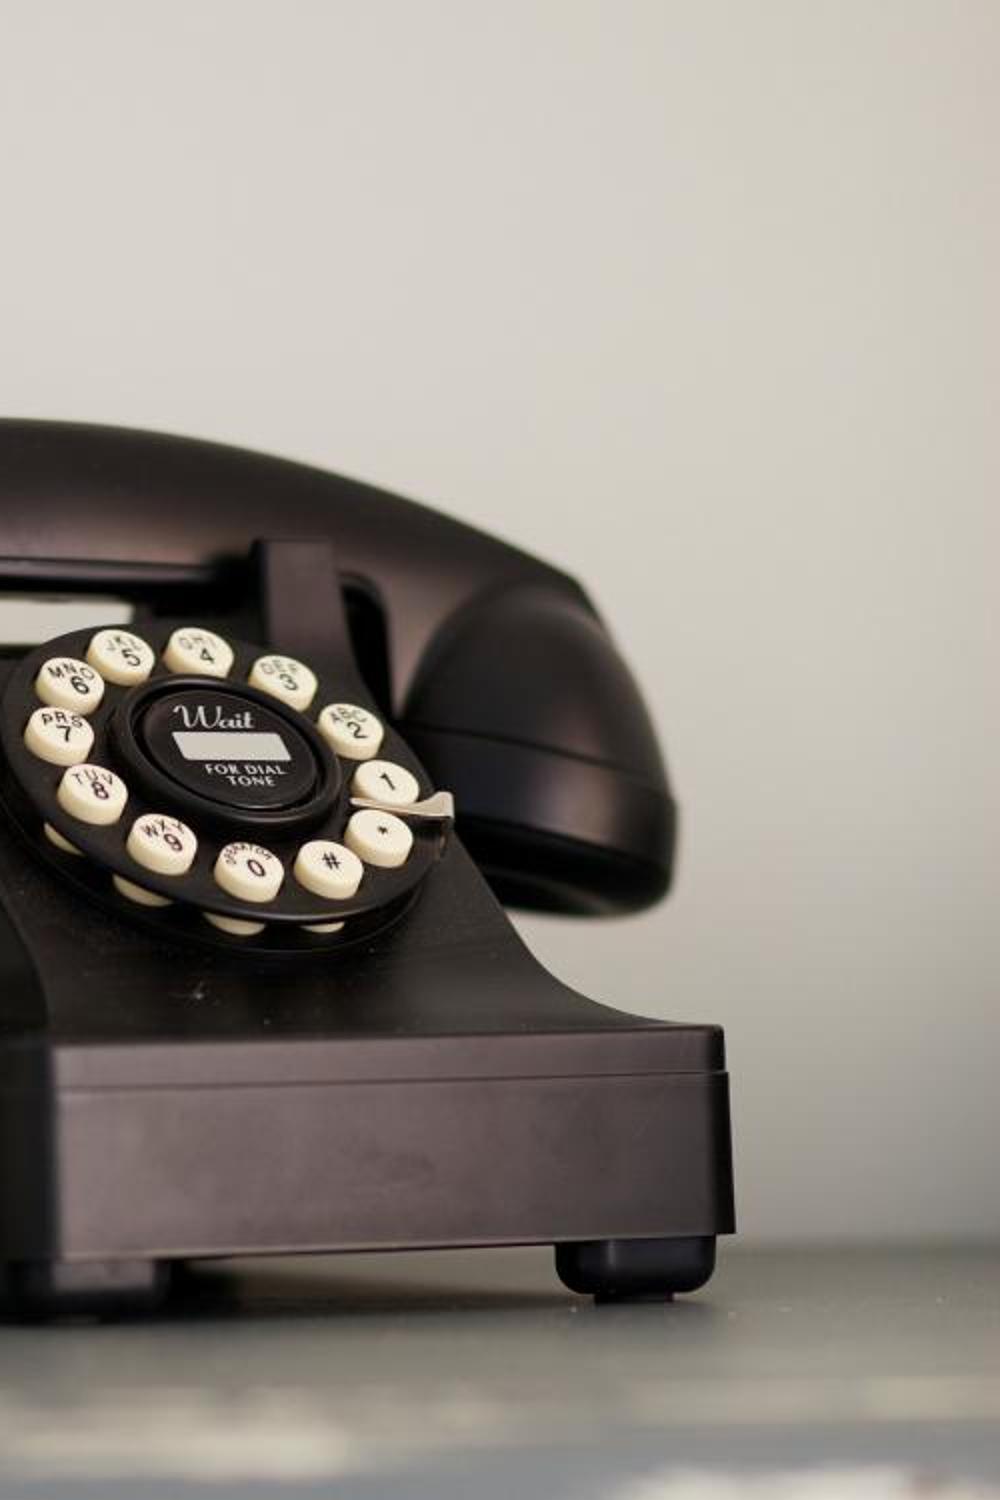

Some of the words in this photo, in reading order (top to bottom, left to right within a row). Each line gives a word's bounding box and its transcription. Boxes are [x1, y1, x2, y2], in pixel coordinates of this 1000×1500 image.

[107, 637, 142, 652] JKL
[121, 648, 141, 667] 5
[200, 647, 215, 664] 4
[47, 662, 96, 681] MNO
[260, 659, 299, 675] DEF
[70, 675, 89, 695] 6
[279, 673, 299, 691] 3
[41, 711, 83, 729] PRS
[172, 705, 254, 728] Wait
[330, 706, 368, 723] ABC
[56, 725, 71, 743] 7
[347, 721, 368, 739] 2
[72, 768, 114, 785] TUV
[204, 763, 241, 775] FOR
[244, 764, 288, 775] DIAL
[226, 775, 277, 787] TONE
[380, 772, 396, 791] 1
[91, 781, 110, 800] 8
[140, 818, 186, 838] WXY
[163, 833, 184, 852] 9
[223, 843, 273, 866] OPERATOR
[321, 851, 342, 871] #
[247, 859, 267, 877] 0
